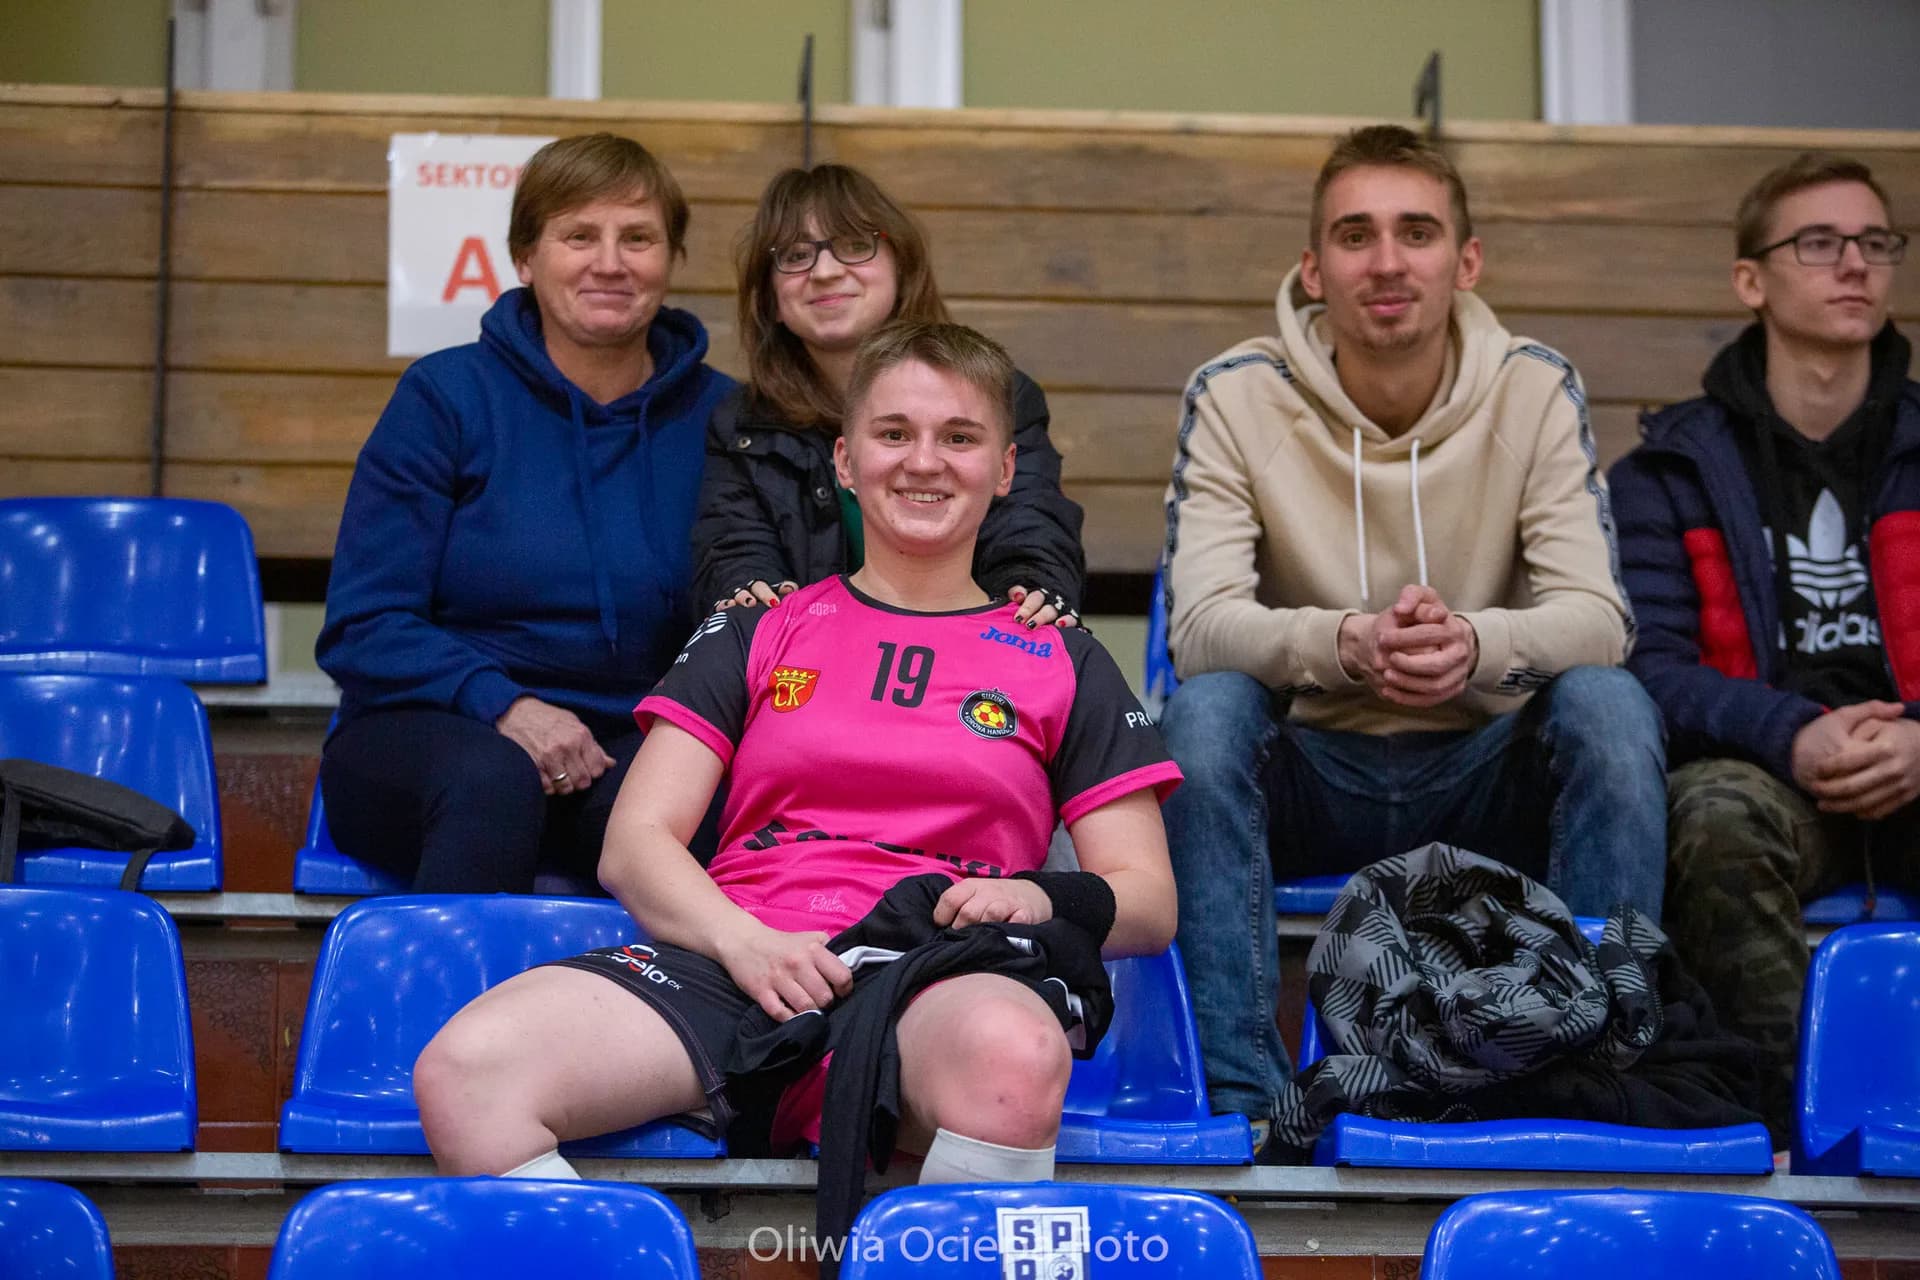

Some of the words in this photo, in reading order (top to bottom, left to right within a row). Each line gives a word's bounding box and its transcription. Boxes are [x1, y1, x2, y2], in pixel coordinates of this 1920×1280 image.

[441, 236, 502, 303] A
[980, 626, 1052, 658] Joma
[774, 682, 806, 707] CK
[870, 641, 936, 708] 19
